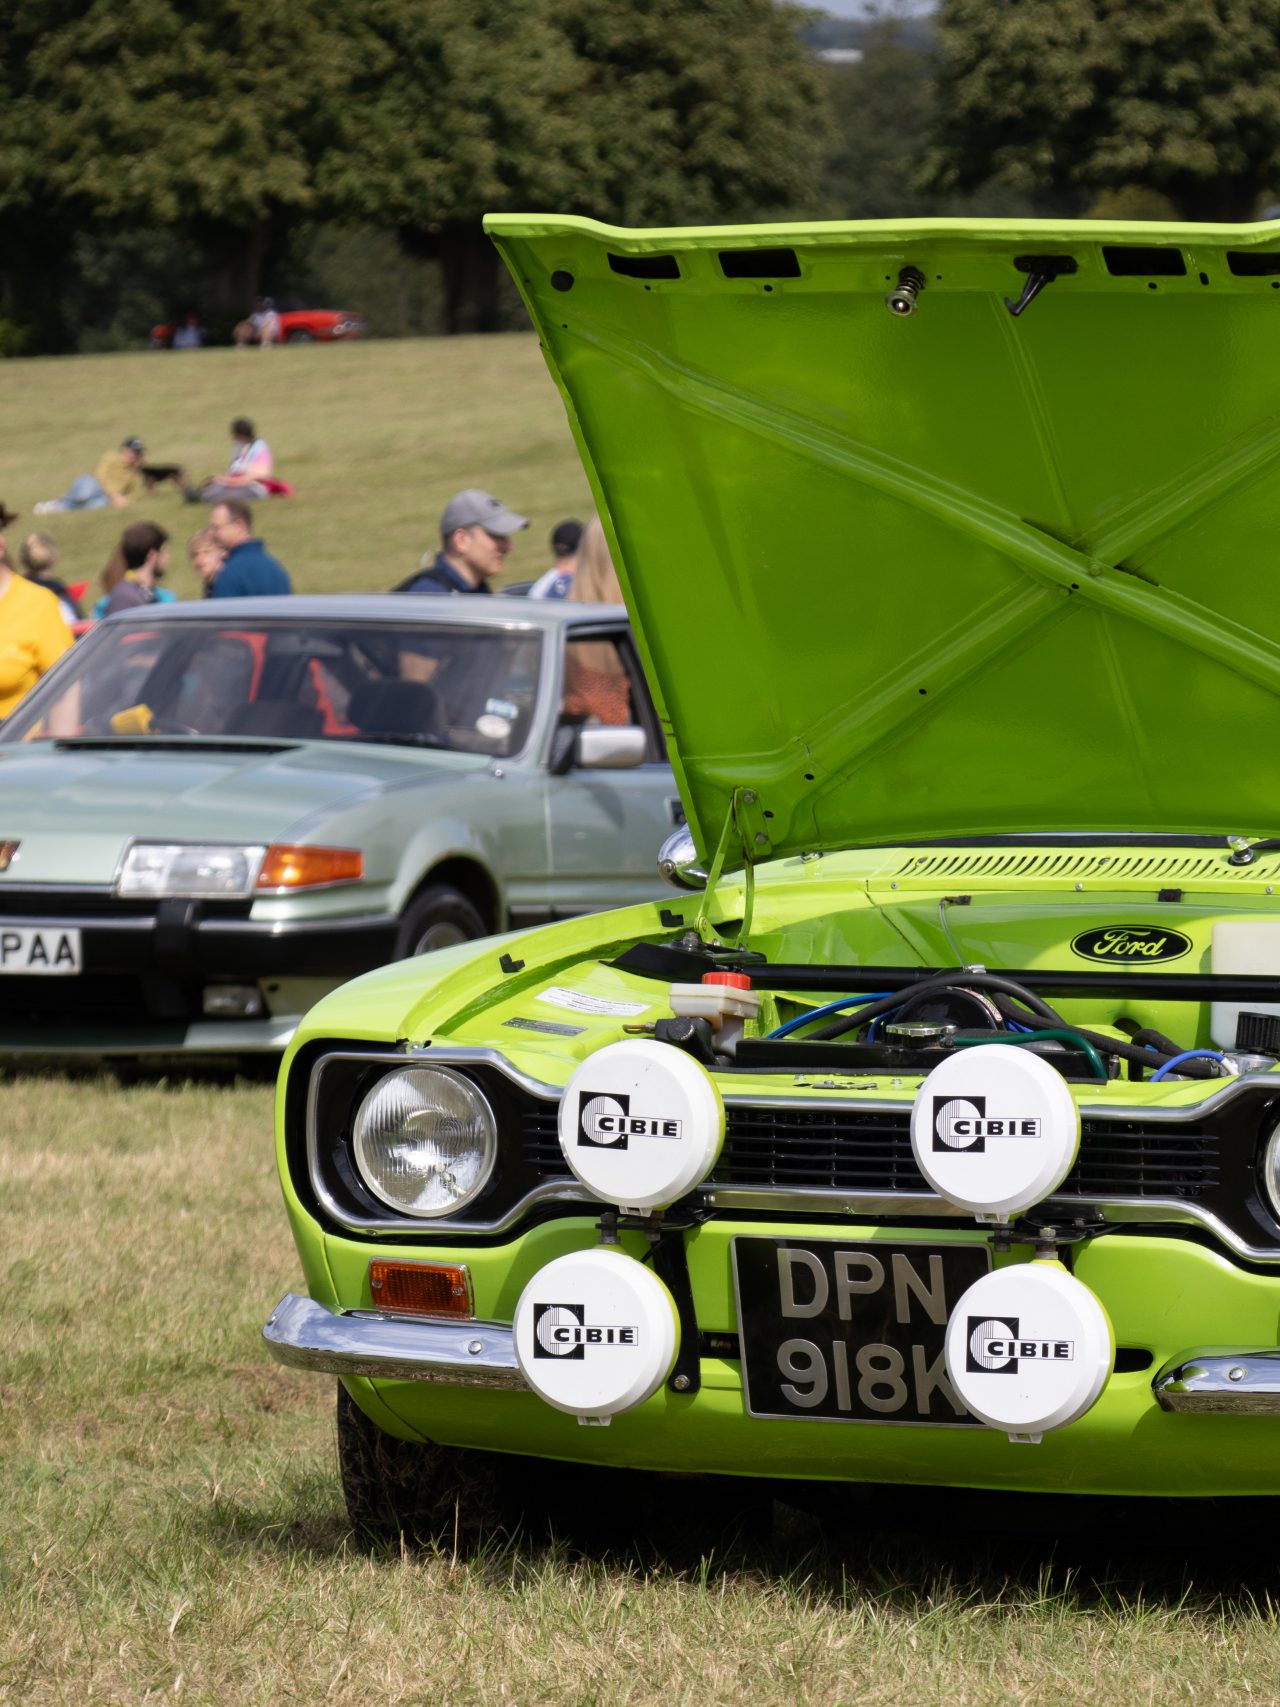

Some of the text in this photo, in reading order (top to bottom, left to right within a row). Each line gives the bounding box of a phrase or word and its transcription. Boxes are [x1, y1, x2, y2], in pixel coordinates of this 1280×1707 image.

[1, 934, 76, 966] PAA
[1093, 929, 1168, 956] Ford
[777, 1248, 948, 1325] DPN
[777, 1338, 968, 1416] 918K
